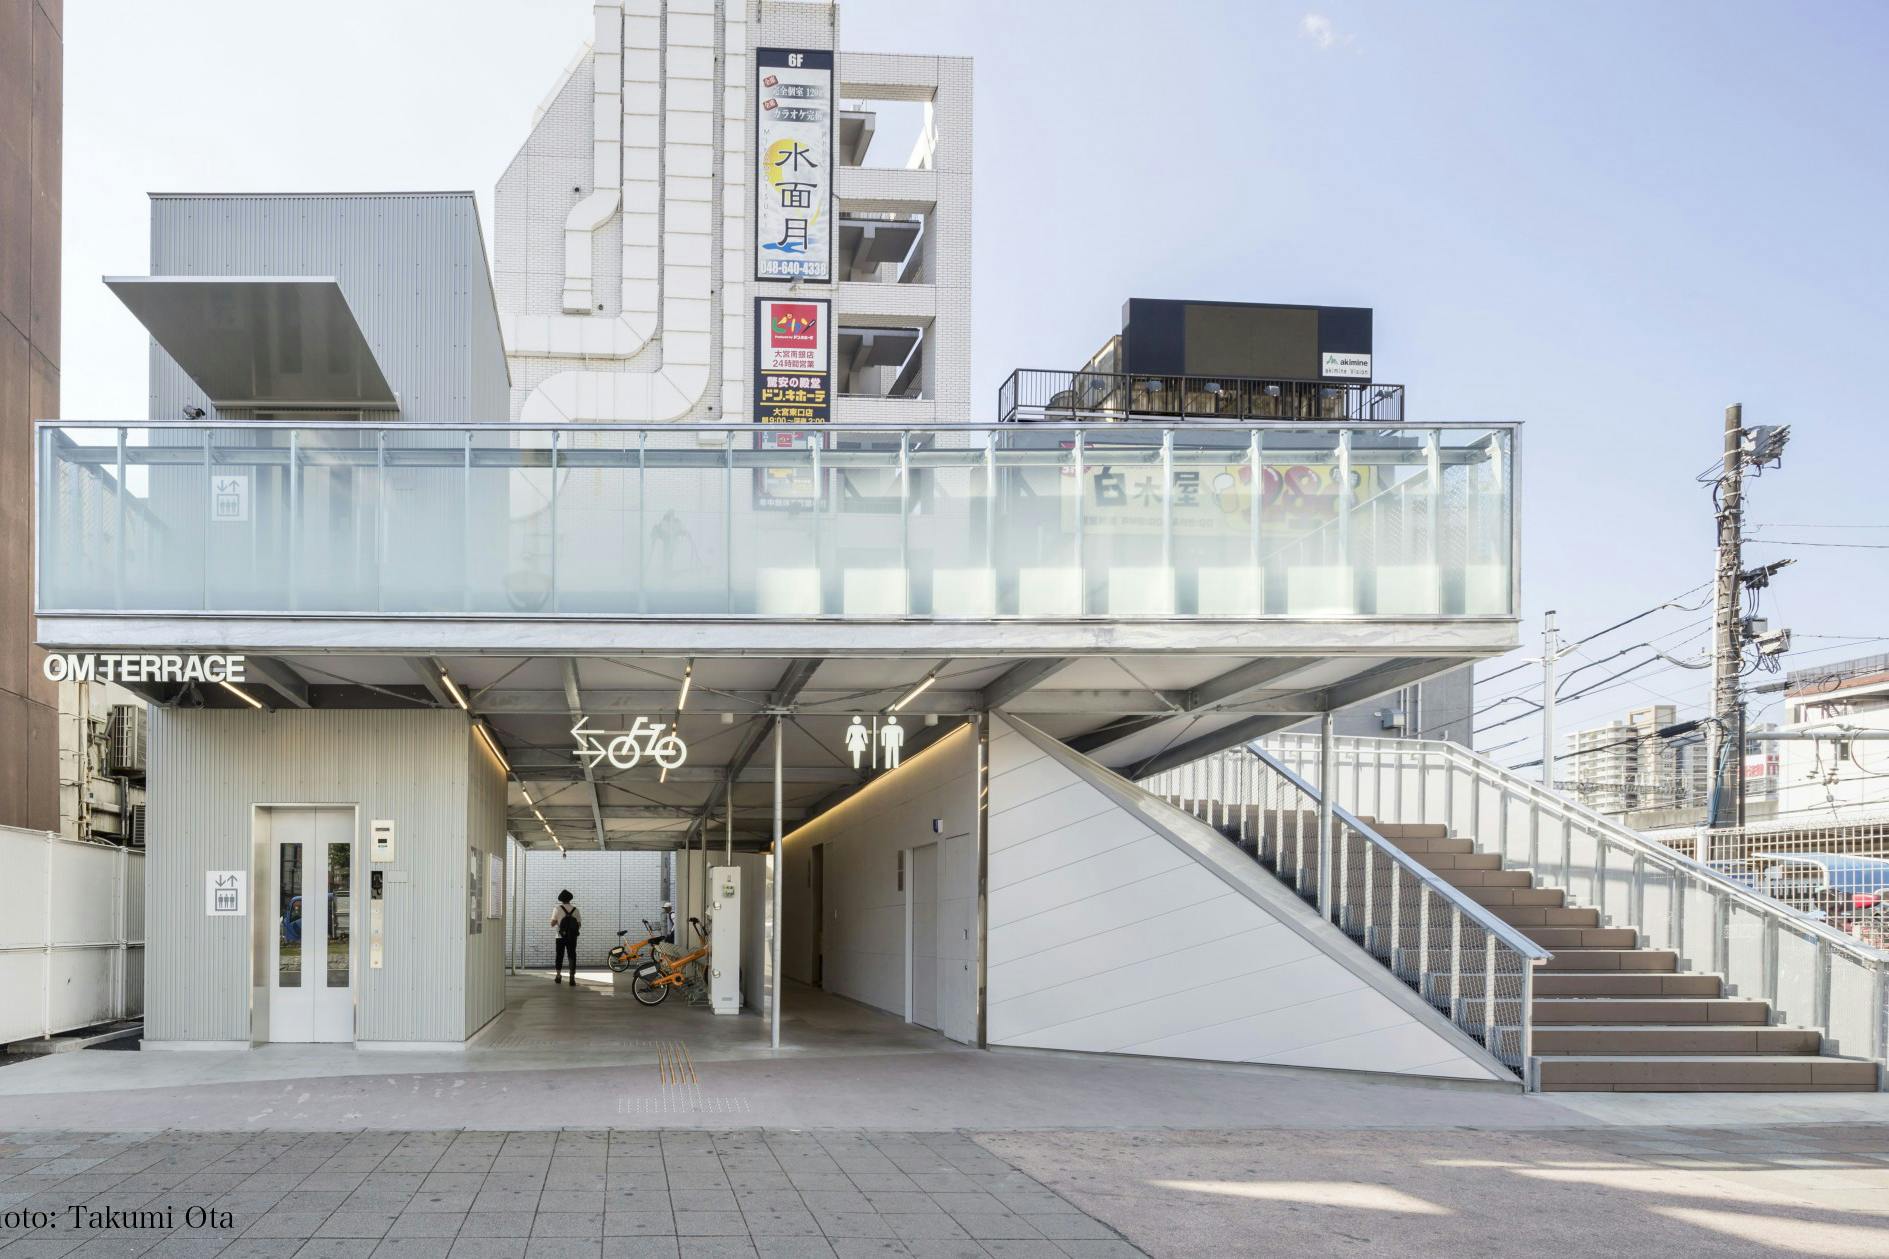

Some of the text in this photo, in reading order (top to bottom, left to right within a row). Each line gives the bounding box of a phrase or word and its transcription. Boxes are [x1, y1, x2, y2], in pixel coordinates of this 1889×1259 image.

[788, 53, 804, 68] 6F
[775, 142, 818, 250] 水面月
[772, 359, 815, 369] 24時間営業
[1340, 358, 1369, 366] akimine
[766, 376, 822, 389] 驚安の殿堂
[772, 407, 814, 417] 大宮東口店
[1094, 466, 1200, 508] 白木屋
[43, 653, 246, 682] OM TERRACE
